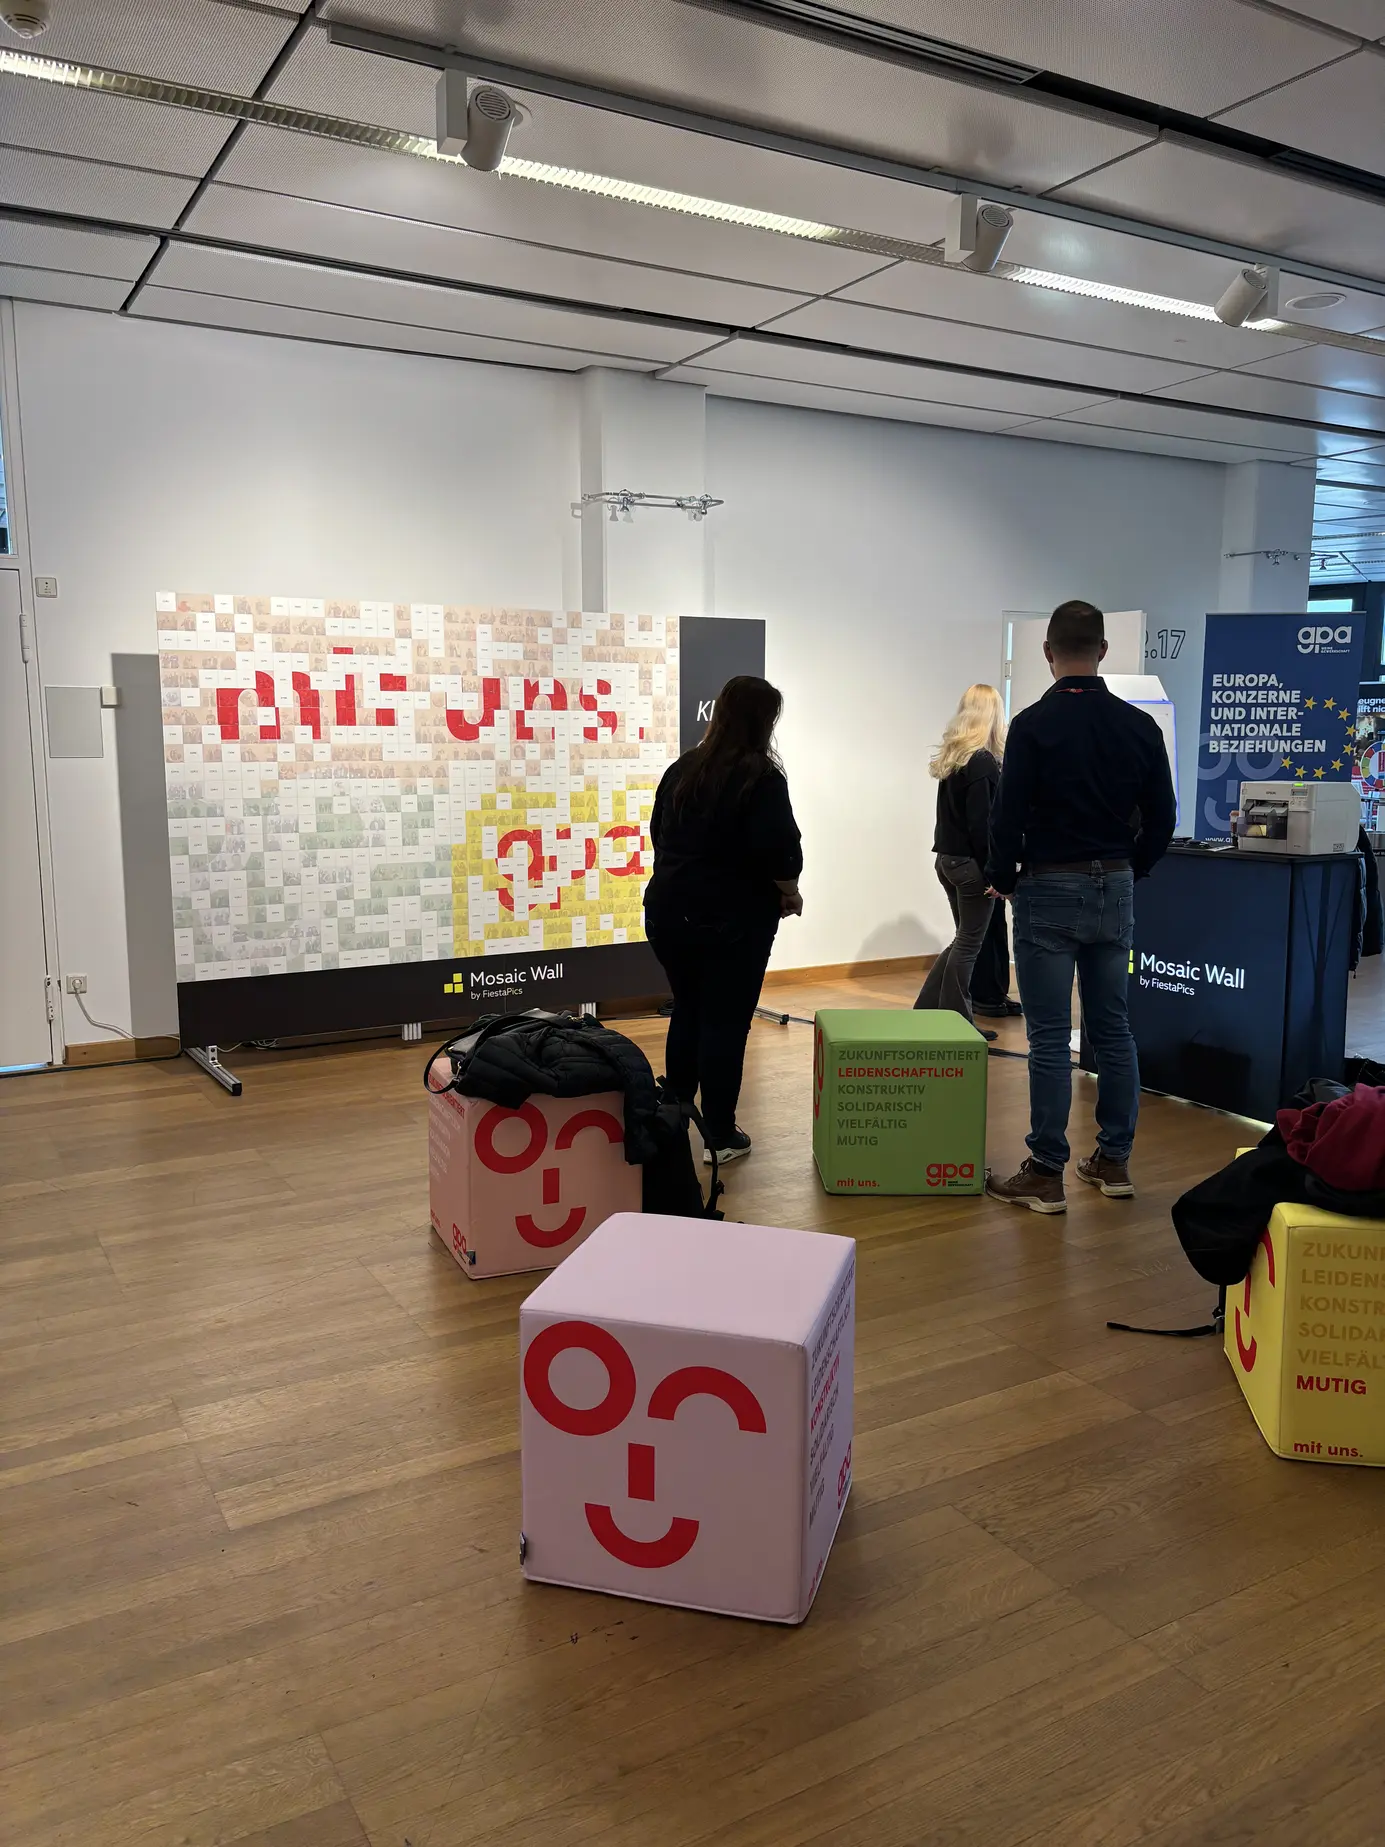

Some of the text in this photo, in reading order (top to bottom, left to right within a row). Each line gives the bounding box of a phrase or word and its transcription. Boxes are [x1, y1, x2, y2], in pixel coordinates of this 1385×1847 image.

[1145, 629, 1186, 659] .17
[1297, 626, 1352, 654] gpa
[1212, 673, 1284, 689] EUROPA,
[1211, 690, 1301, 704] KONZERNE
[1210, 707, 1304, 720] UND INTER-
[1210, 723, 1301, 737] NATIONALE
[1209, 739, 1326, 753] BEZIEHUNGEN
[470, 963, 563, 988] Mosaic Wall
[1140, 953, 1245, 989] Mosaic Wall
[1139, 976, 1195, 996] by FiestaPics
[470, 987, 523, 1001] by FiestaPics
[838, 1050, 980, 1061] ZUKUNFTSORIENTIERT
[838, 1067, 964, 1078] LEIDENSCHAFTLICH
[837, 1084, 926, 1095] KONSTRUKTIV
[837, 1101, 922, 1112] SOLIDARISCH
[837, 1118, 907, 1129] VIELFÄLTIG
[837, 1136, 879, 1146] MUTIG
[837, 1177, 880, 1187] mit uns.
[926, 1163, 975, 1187] gpa
[1296, 1374, 1367, 1395] MUTIG
[1293, 1440, 1363, 1458] mit uns.
